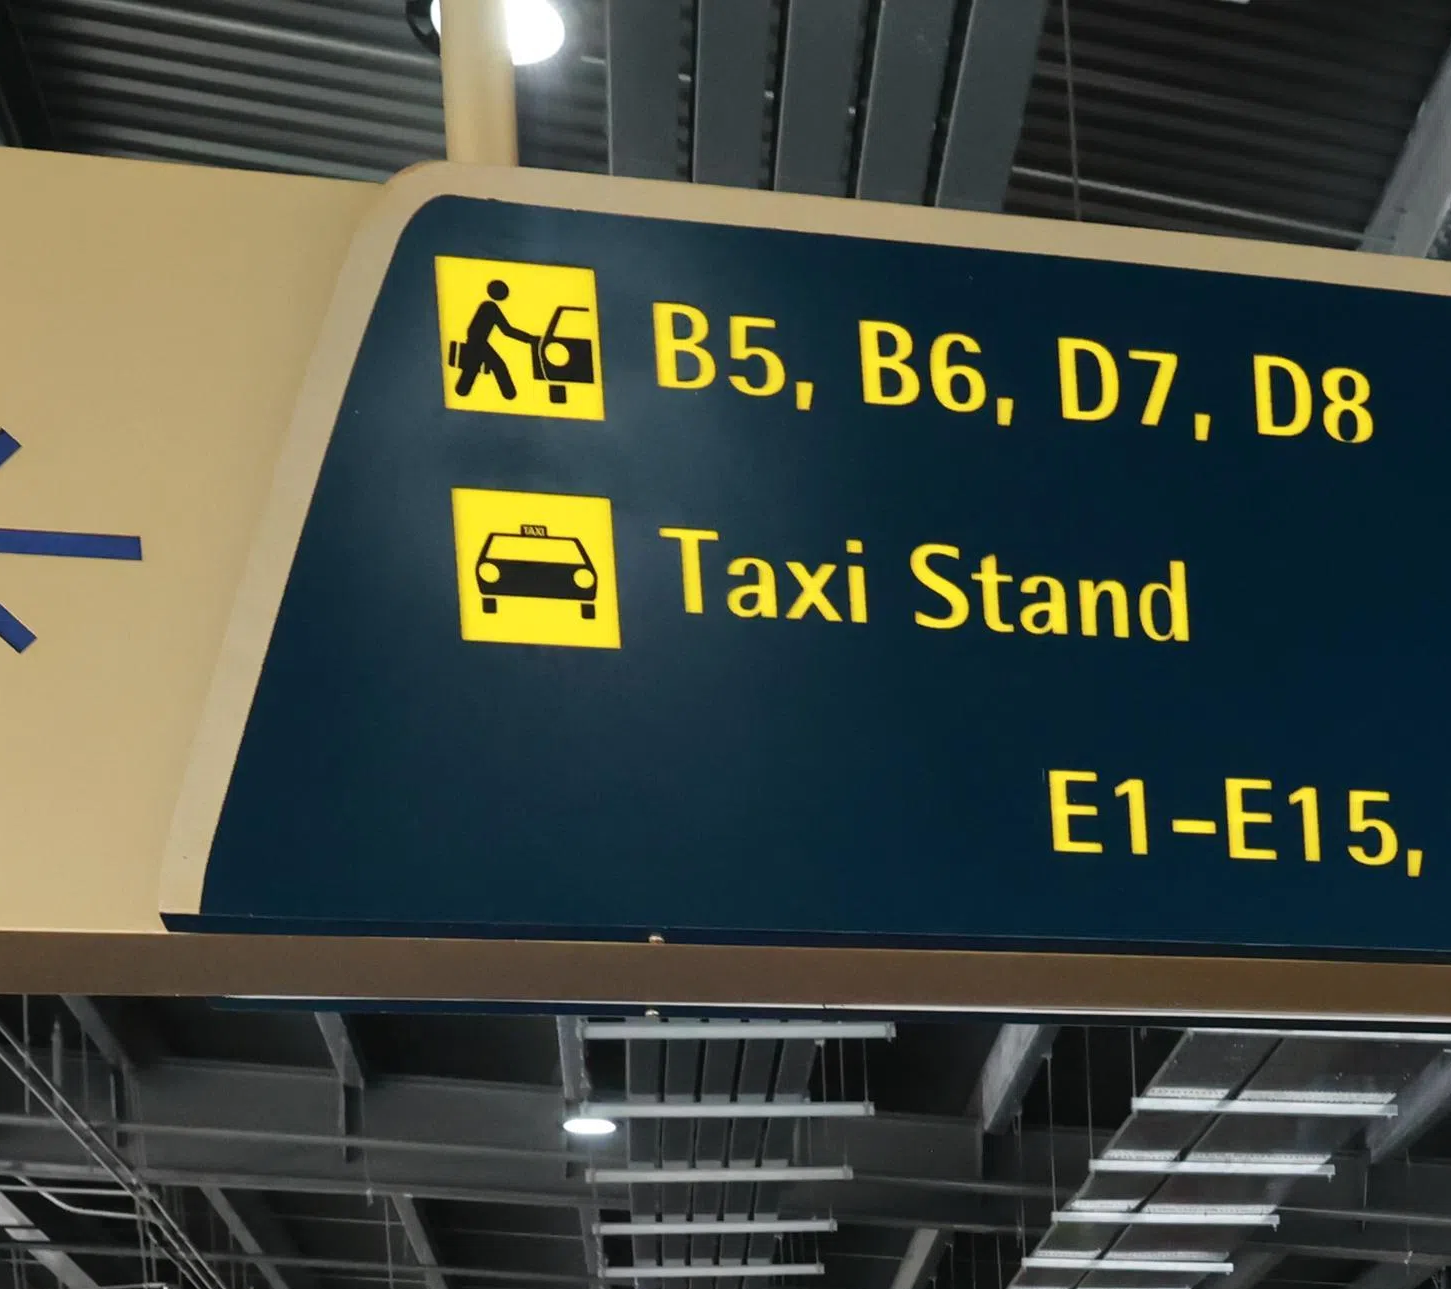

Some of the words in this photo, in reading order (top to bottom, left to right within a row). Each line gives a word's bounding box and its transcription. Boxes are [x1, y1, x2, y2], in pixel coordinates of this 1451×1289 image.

[652, 302, 813, 410] B5,
[859, 320, 1013, 426] B6,
[1058, 337, 1211, 441] D7,
[1253, 355, 1374, 443] D8
[659, 527, 867, 623] Taxi
[910, 543, 1190, 642] Stand
[1049, 770, 1423, 877] E1-E15,
